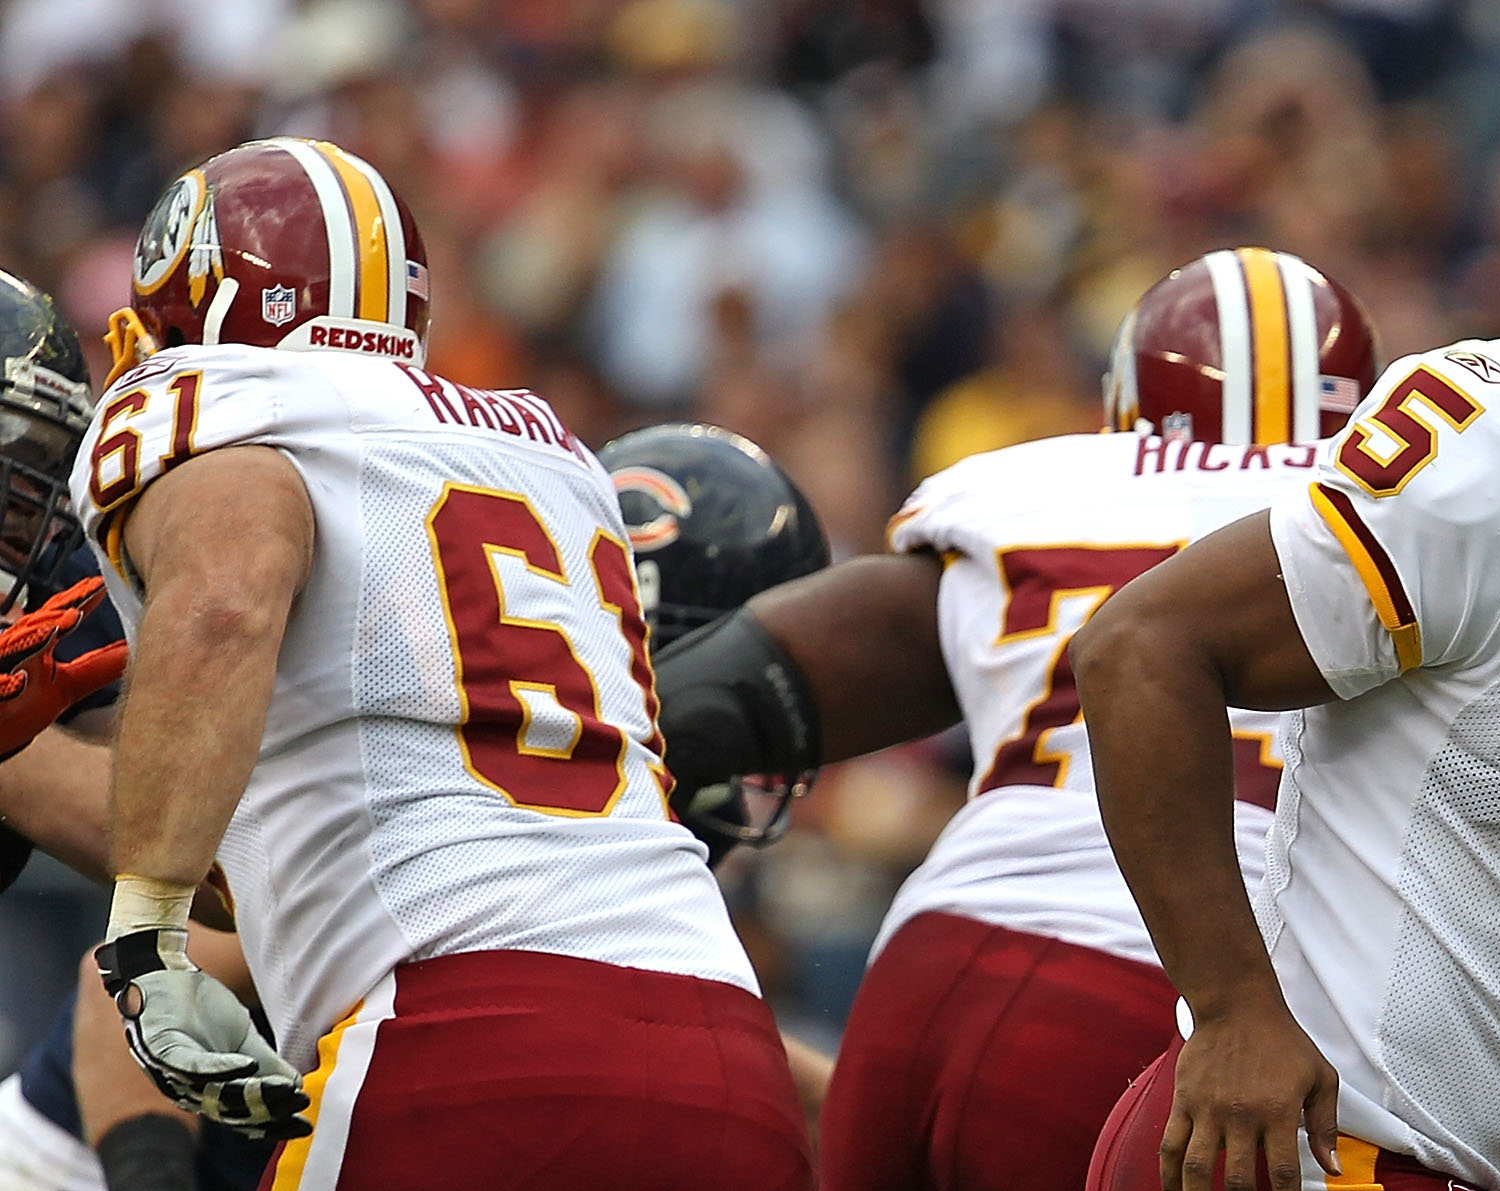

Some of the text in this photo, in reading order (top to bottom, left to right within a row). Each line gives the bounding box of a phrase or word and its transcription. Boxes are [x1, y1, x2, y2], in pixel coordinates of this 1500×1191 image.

[267, 302, 292, 319] NFL
[310, 325, 414, 360] REDSKINS
[88, 368, 204, 513] 61
[1334, 362, 1487, 499] 5
